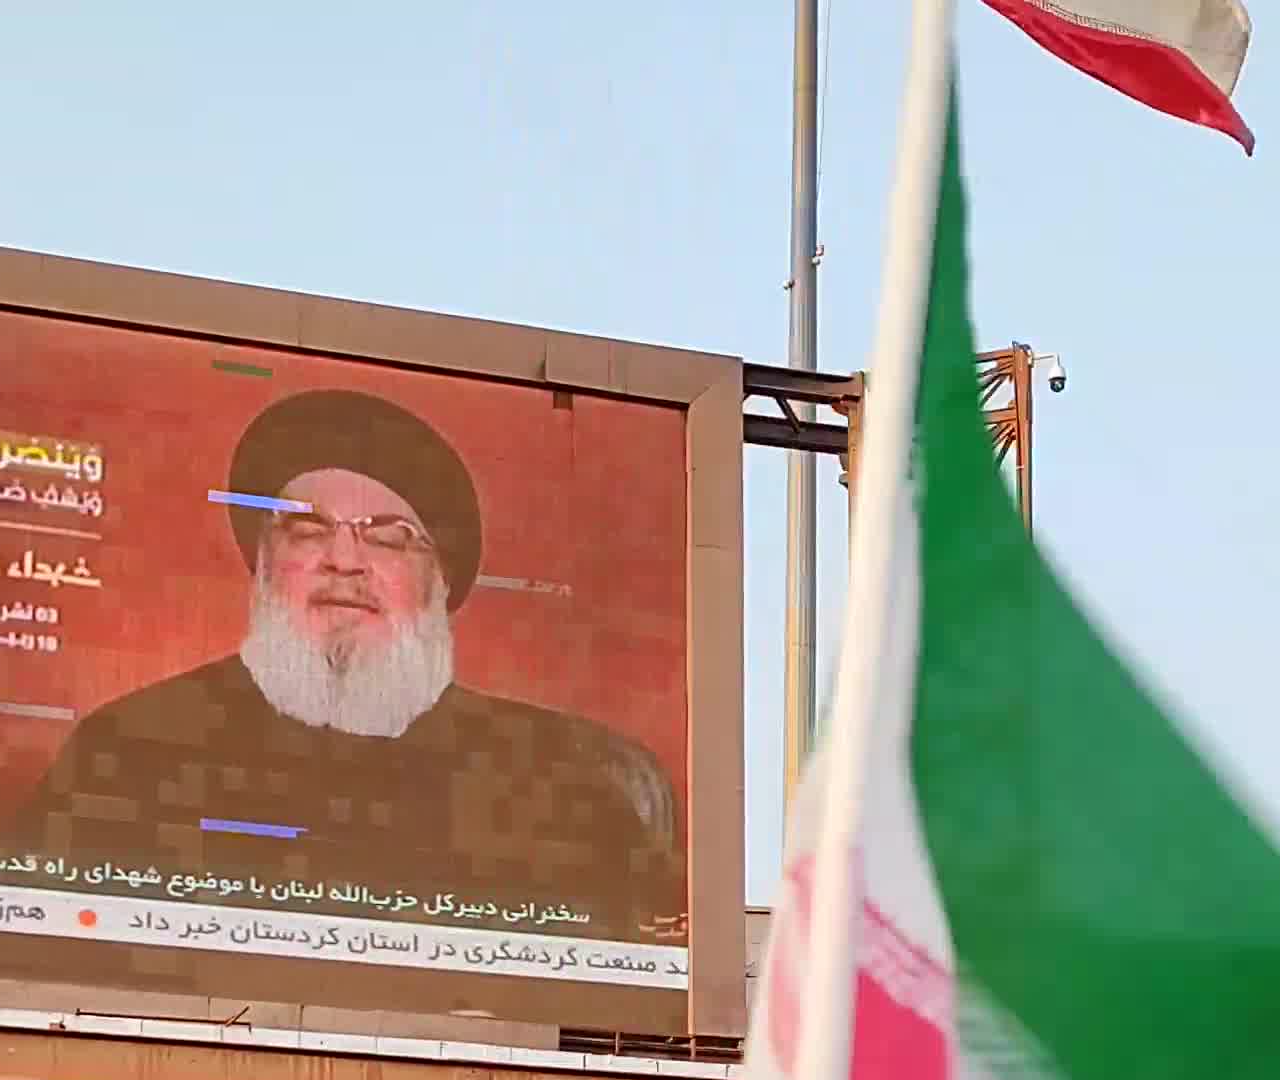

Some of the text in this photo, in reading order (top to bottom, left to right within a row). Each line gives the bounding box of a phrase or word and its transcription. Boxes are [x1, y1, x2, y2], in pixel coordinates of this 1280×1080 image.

[7, 549, 103, 588] شهداء
[45, 857, 78, 882] راه
[84, 862, 162, 888] شهدای
[166, 871, 244, 897] موضوع
[249, 876, 266, 899] با
[271, 881, 324, 904] لبنان
[423, 893, 497, 919] دبیرکل
[502, 902, 591, 925] سخنرانی
[128, 911, 169, 931] داد
[178, 915, 221, 940] خبر
[230, 920, 340, 951] کردستان
[347, 931, 418, 954] استان
[429, 942, 456, 961] در
[464, 940, 578, 971] گردشگری
[585, 952, 657, 973] صنعت
